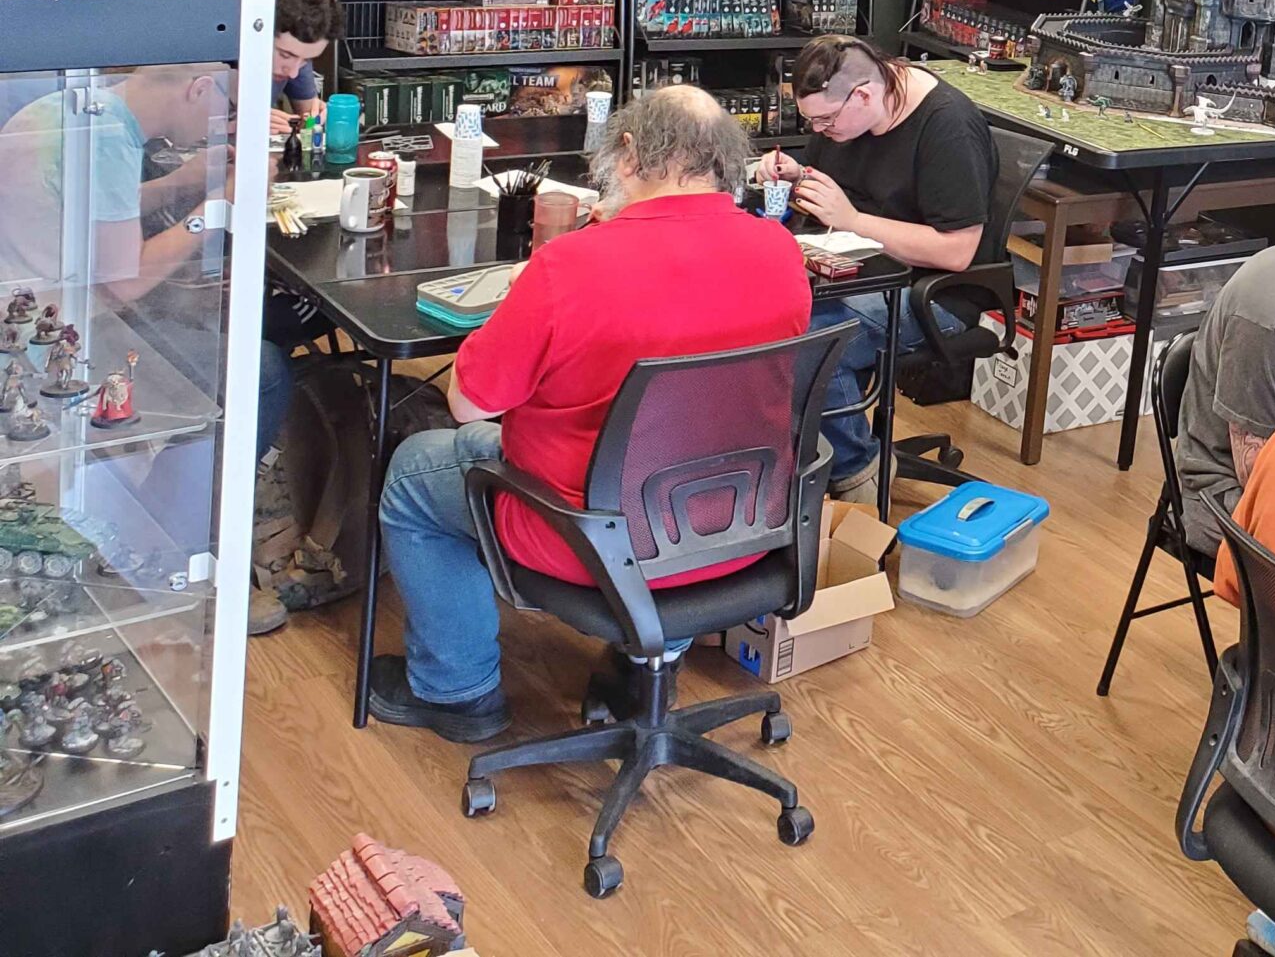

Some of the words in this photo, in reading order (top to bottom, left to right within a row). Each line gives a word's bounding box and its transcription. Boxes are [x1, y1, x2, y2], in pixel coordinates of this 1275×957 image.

[521, 75, 555, 87] TEAM
[480, 102, 507, 113] GARD
[1063, 144, 1079, 156] FLG
